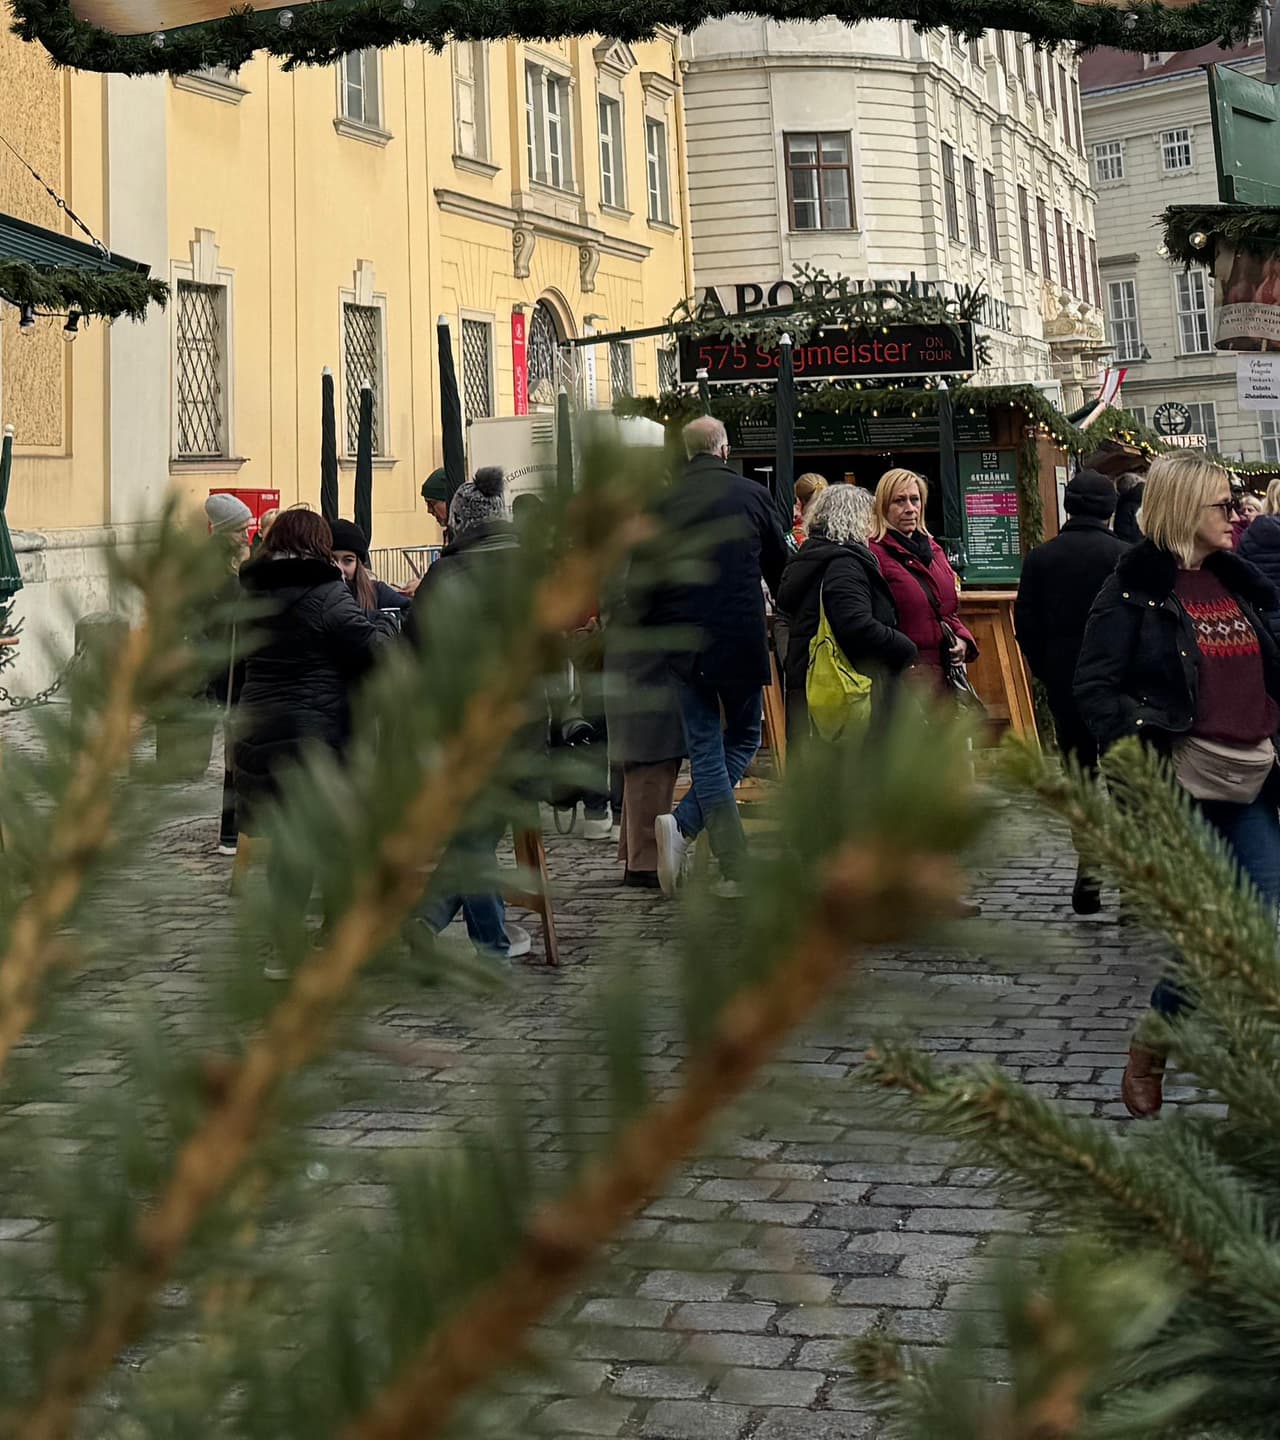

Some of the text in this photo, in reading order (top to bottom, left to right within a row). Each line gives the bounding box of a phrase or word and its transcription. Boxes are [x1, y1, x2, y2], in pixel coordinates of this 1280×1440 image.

[698, 335, 944, 374] 575 Sagmeister ON
[920, 349, 952, 361] TOUR
